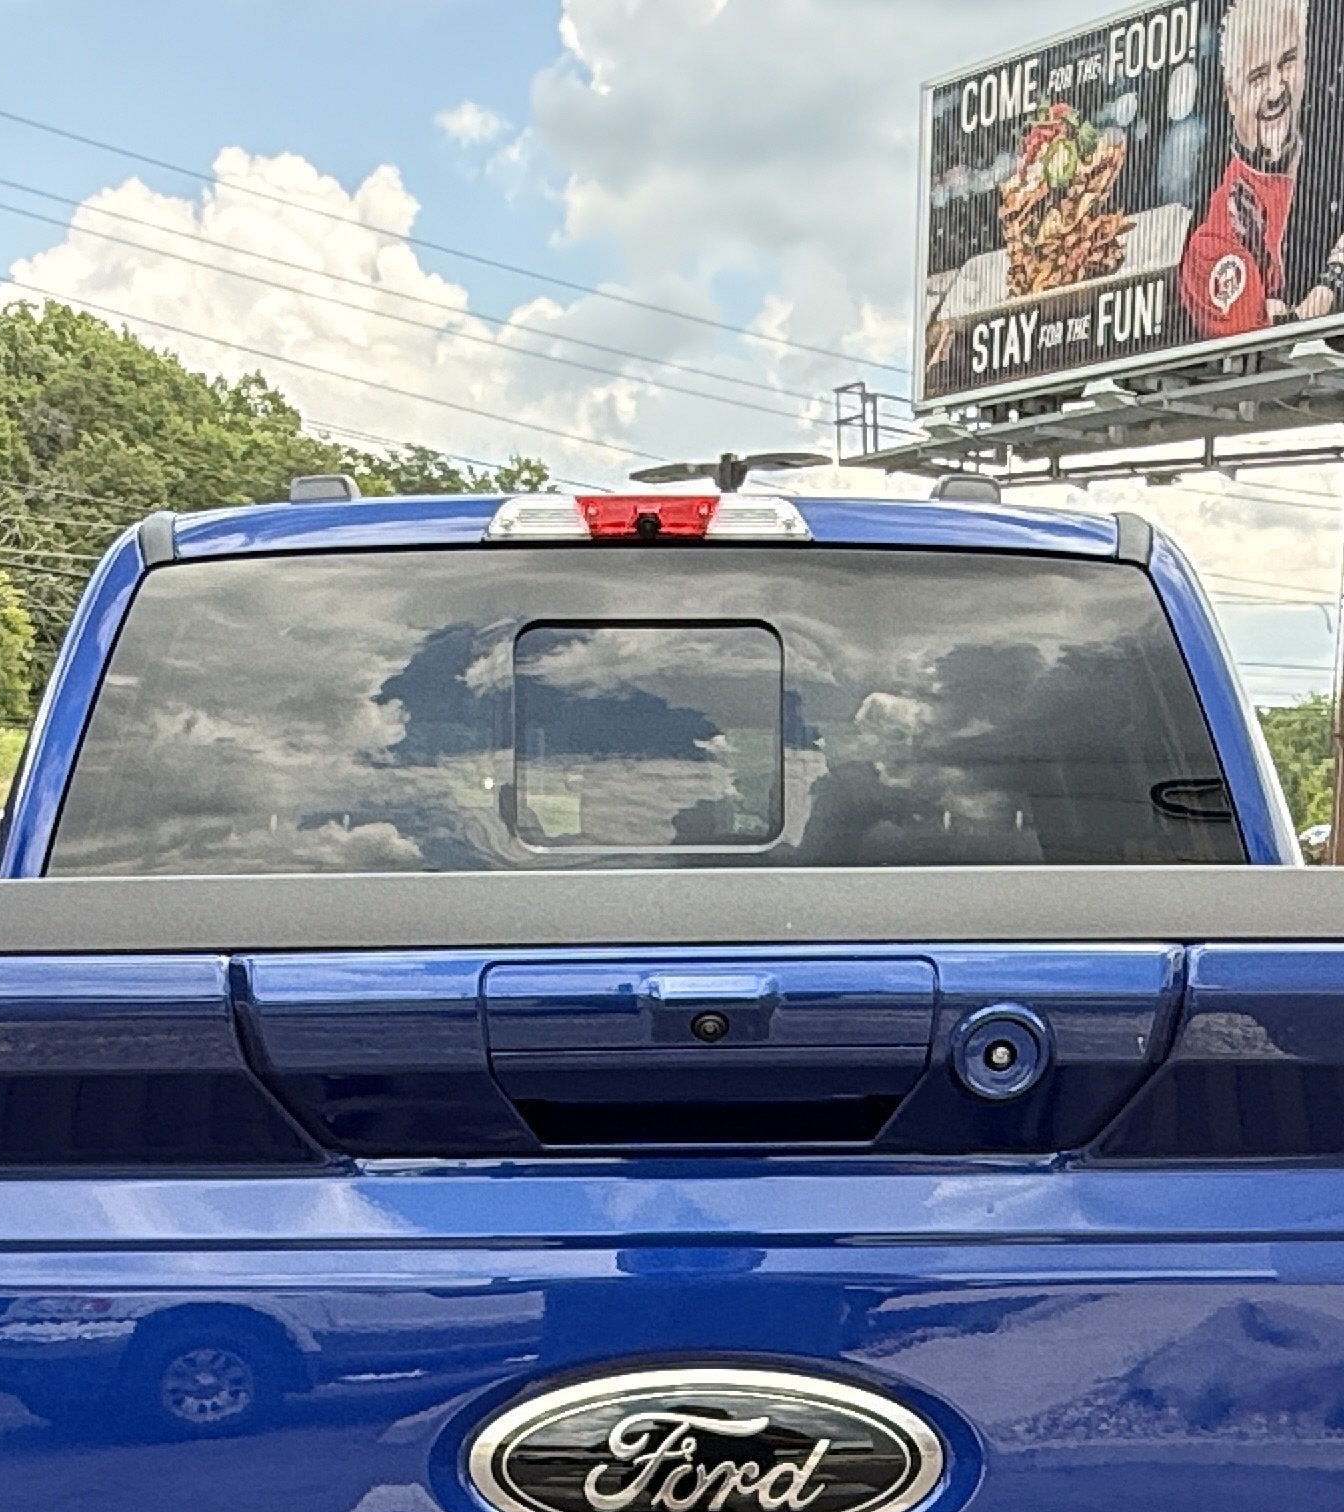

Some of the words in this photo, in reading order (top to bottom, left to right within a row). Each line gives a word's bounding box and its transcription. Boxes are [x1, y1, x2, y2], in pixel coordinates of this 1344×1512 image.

[961, 58, 1039, 134] COME
[1047, 64, 1073, 94] FOR
[1076, 53, 1102, 85] THE
[1108, 2, 1199, 85] FOOD!
[972, 310, 1040, 374] STAY
[1066, 313, 1092, 345] THE
[1097, 279, 1165, 348] FUN!
